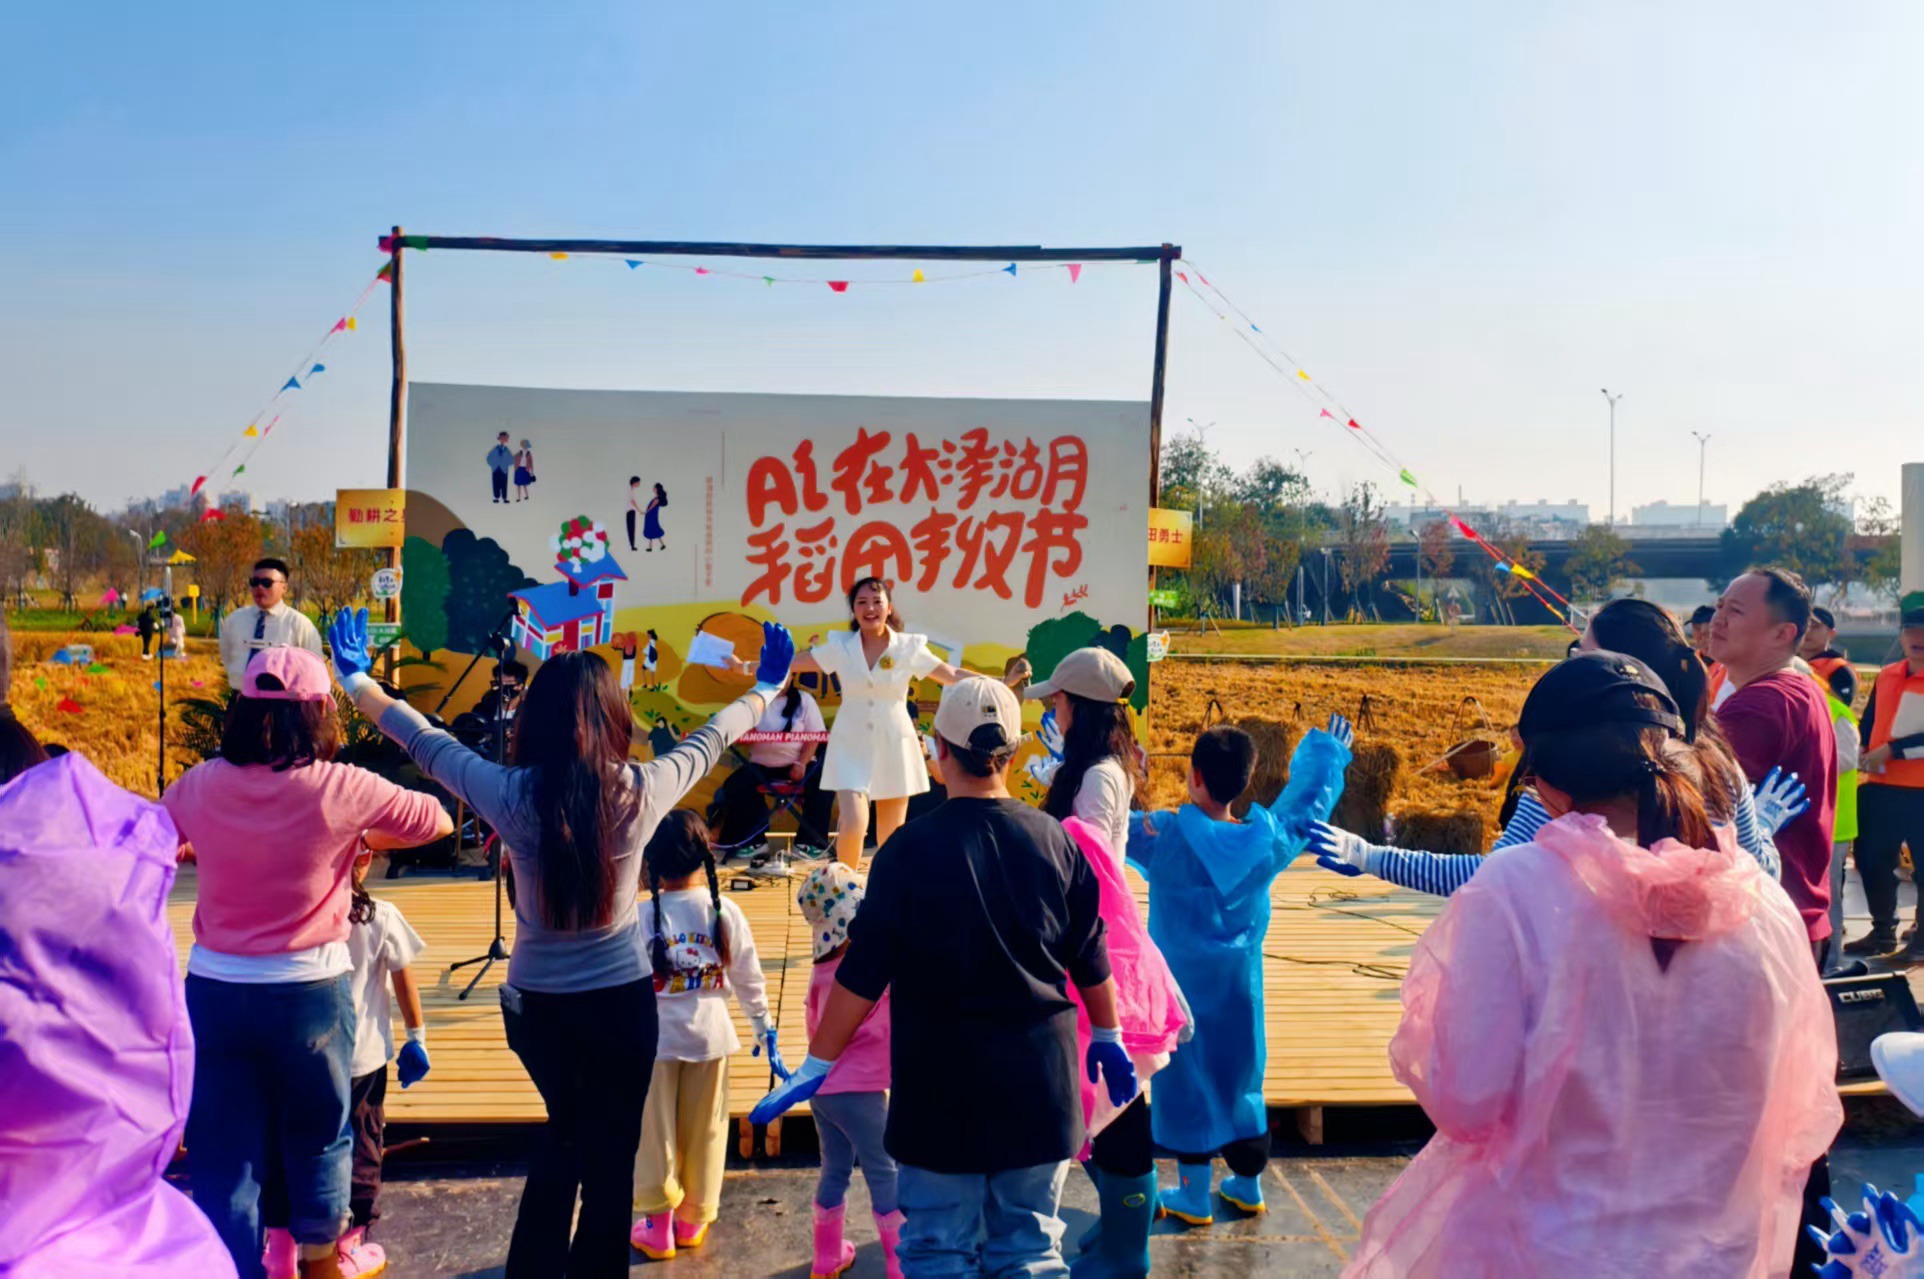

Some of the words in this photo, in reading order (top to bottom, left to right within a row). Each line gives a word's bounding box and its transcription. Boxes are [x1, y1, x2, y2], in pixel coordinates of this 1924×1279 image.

[349, 507, 404, 523] 勤耕之
[740, 506, 1089, 609] 稻田丰收节
[738, 732, 783, 742] IANOMAN
[784, 732, 829, 742] PIANOMA
